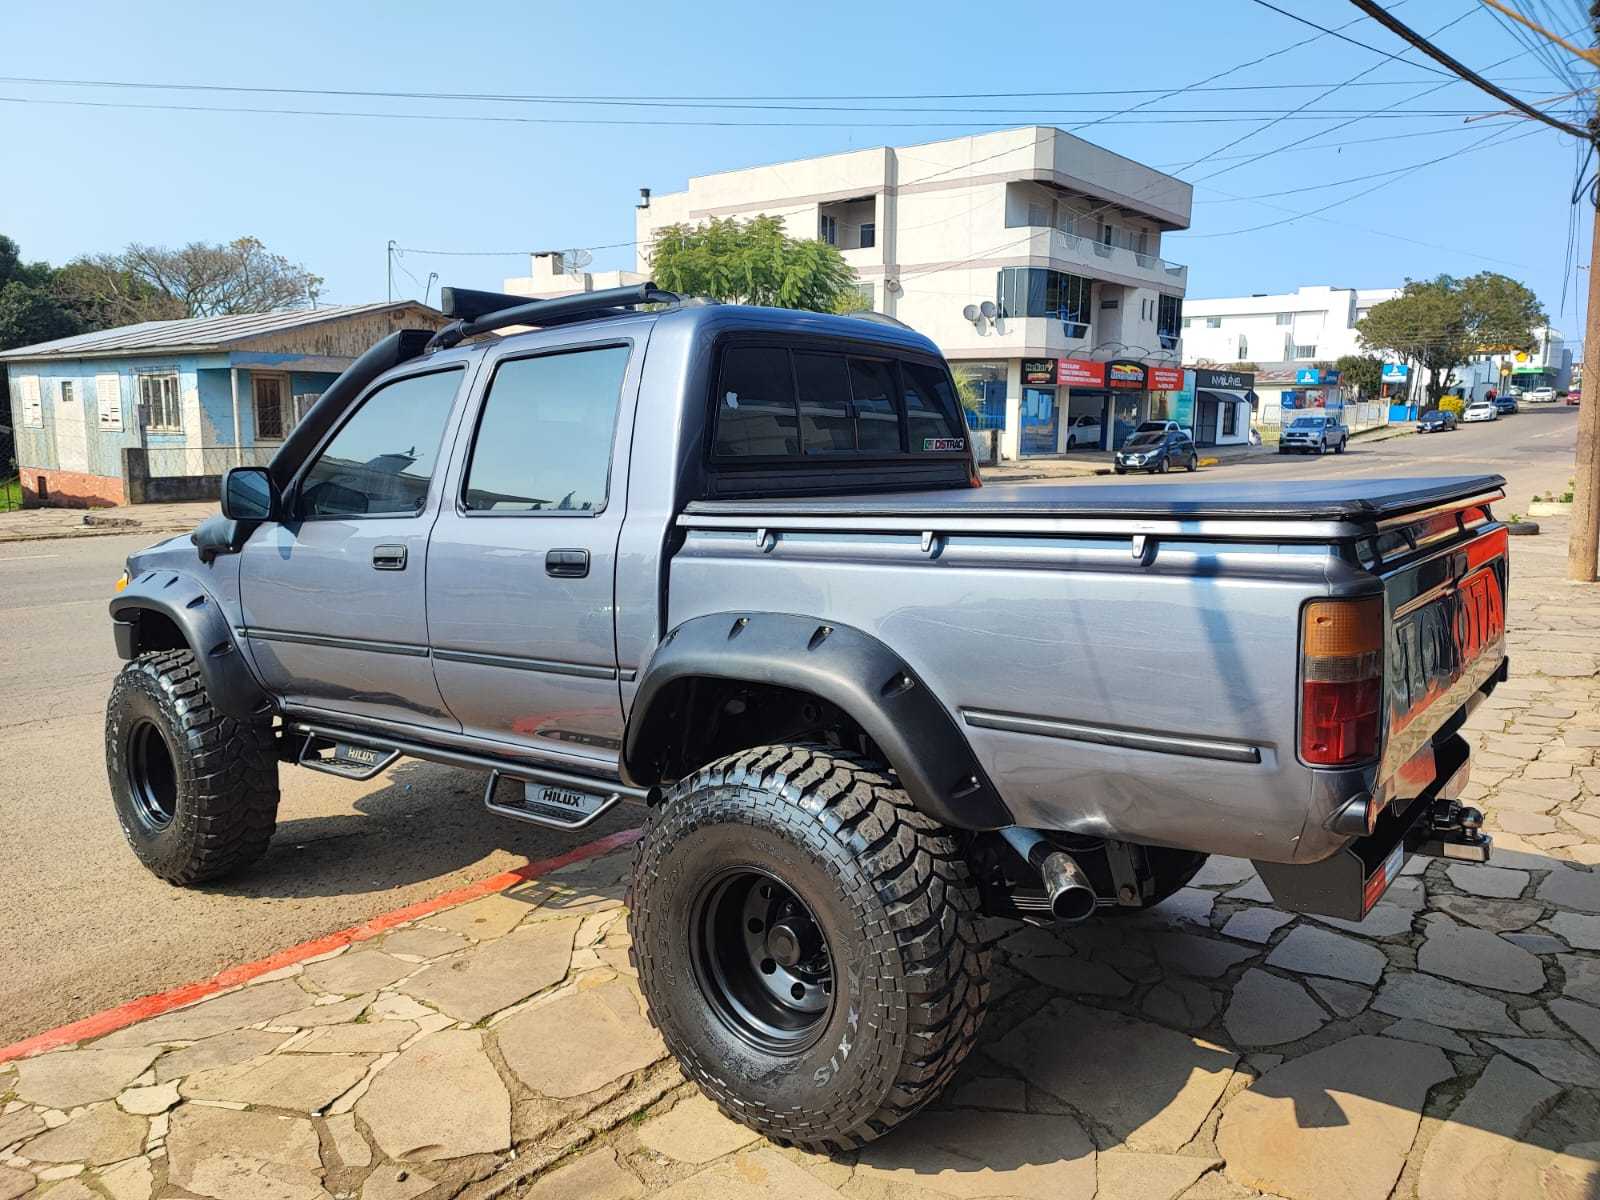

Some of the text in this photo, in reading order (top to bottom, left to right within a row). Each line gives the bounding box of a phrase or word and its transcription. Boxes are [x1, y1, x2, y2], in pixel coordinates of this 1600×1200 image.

[1394, 571, 1503, 709] TOYOTA
[347, 746, 375, 763] HILUX
[543, 790, 580, 808] HILUX
